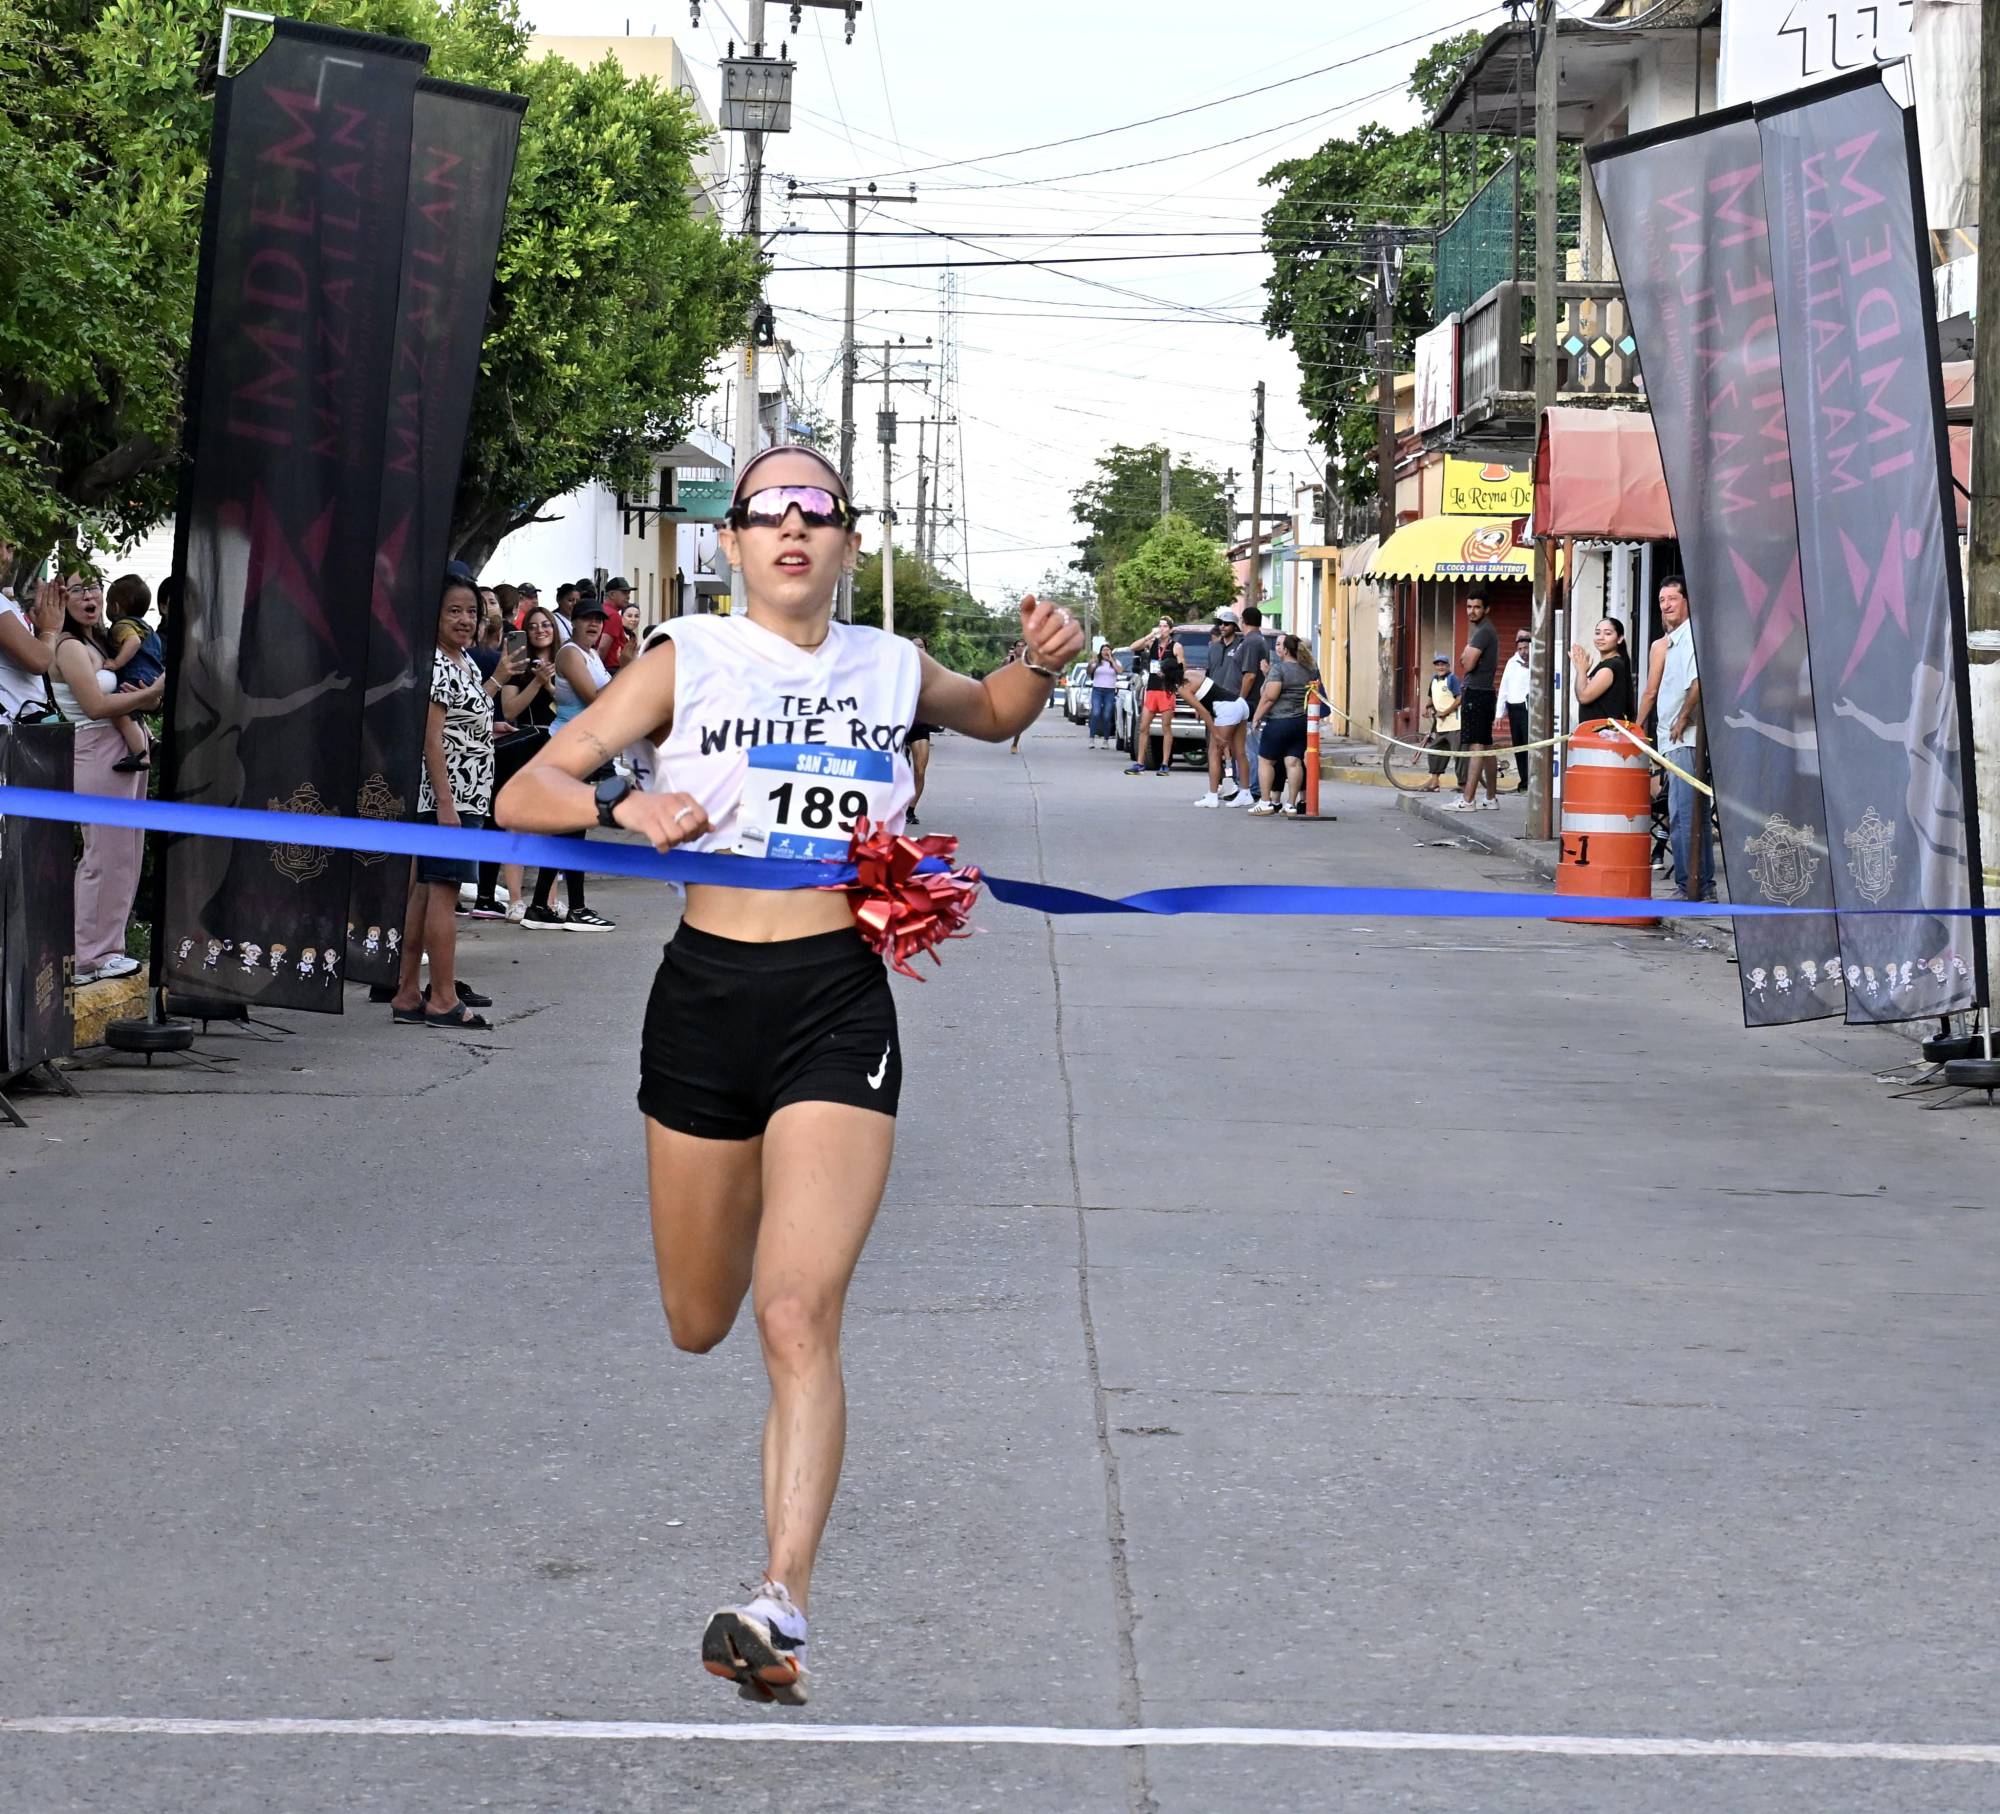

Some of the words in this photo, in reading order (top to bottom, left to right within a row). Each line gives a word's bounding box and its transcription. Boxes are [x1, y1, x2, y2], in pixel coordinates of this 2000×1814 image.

[226, 83, 322, 448] IMDEM
[1450, 487, 1467, 510] La
[1468, 487, 1507, 510] Reyna
[1511, 487, 1531, 508] De
[1476, 564, 1487, 572] LOS
[1488, 564, 1525, 573] ZAPATEROS
[779, 695, 858, 717] TEAM
[701, 717, 828, 755] WHITE
[796, 754, 822, 773] SAN
[823, 756, 857, 777] JUAN
[768, 782, 869, 834] 189
